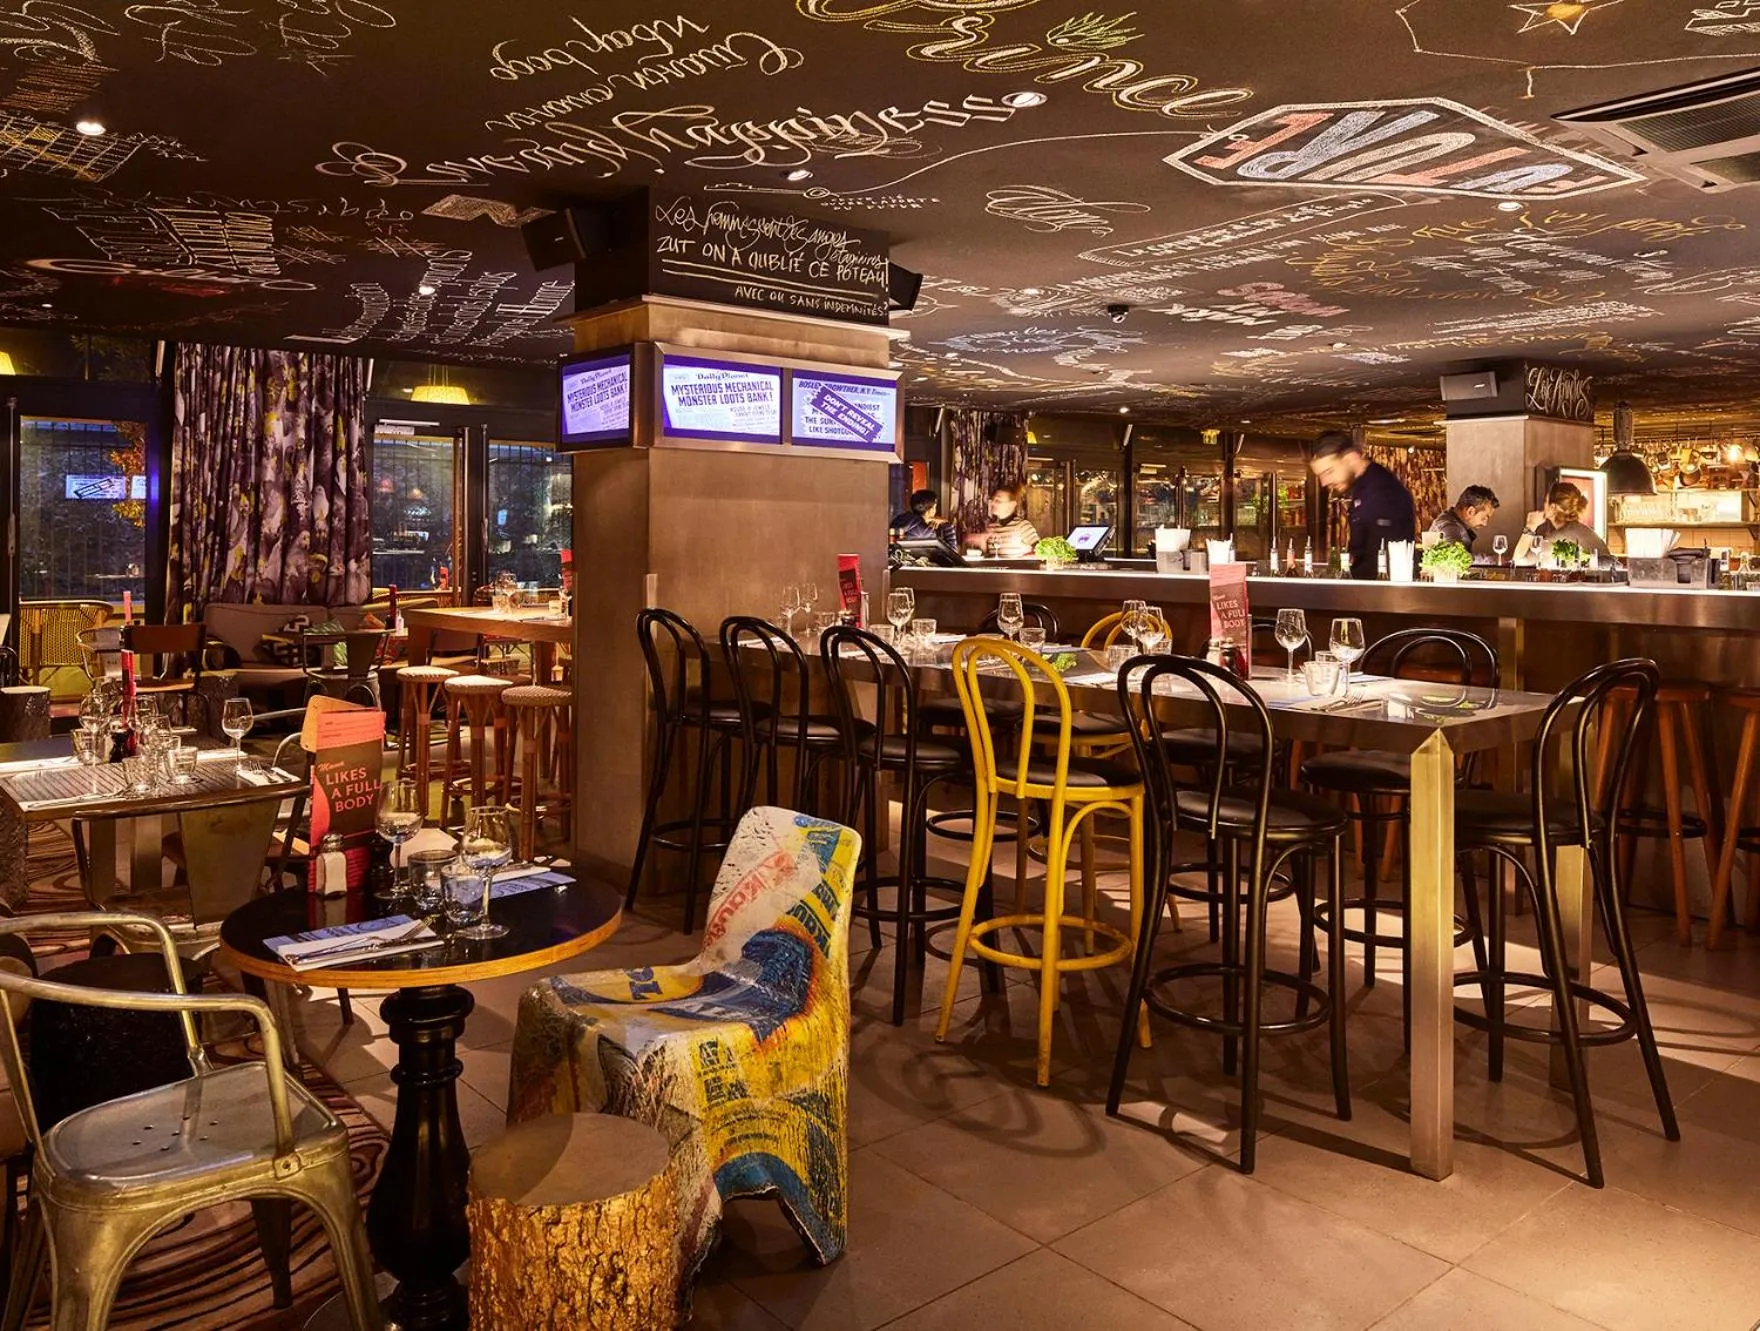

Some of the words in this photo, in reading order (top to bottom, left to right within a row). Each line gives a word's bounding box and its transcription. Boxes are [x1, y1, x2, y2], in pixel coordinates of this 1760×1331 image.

[602, 94, 1018, 169] happiness
[656, 236, 696, 254] ZUT
[702, 242, 726, 264] ON
[731, 251, 742, 267] A
[808, 261, 830, 279] CE
[734, 286, 765, 301] AVEC
[769, 291, 785, 303] OU
[790, 294, 821, 309] SANS
[671, 382, 724, 396] MYSTERIOUS
[725, 380, 774, 393] MECHANICAL
[677, 394, 718, 407] MONSTER
[720, 392, 745, 405] LOOTS
[1216, 600, 1239, 610] LIKES
[326, 767, 368, 785] LIKES
[331, 788, 343, 799] A
[346, 779, 383, 796] FULL
[335, 794, 374, 812] BODY
